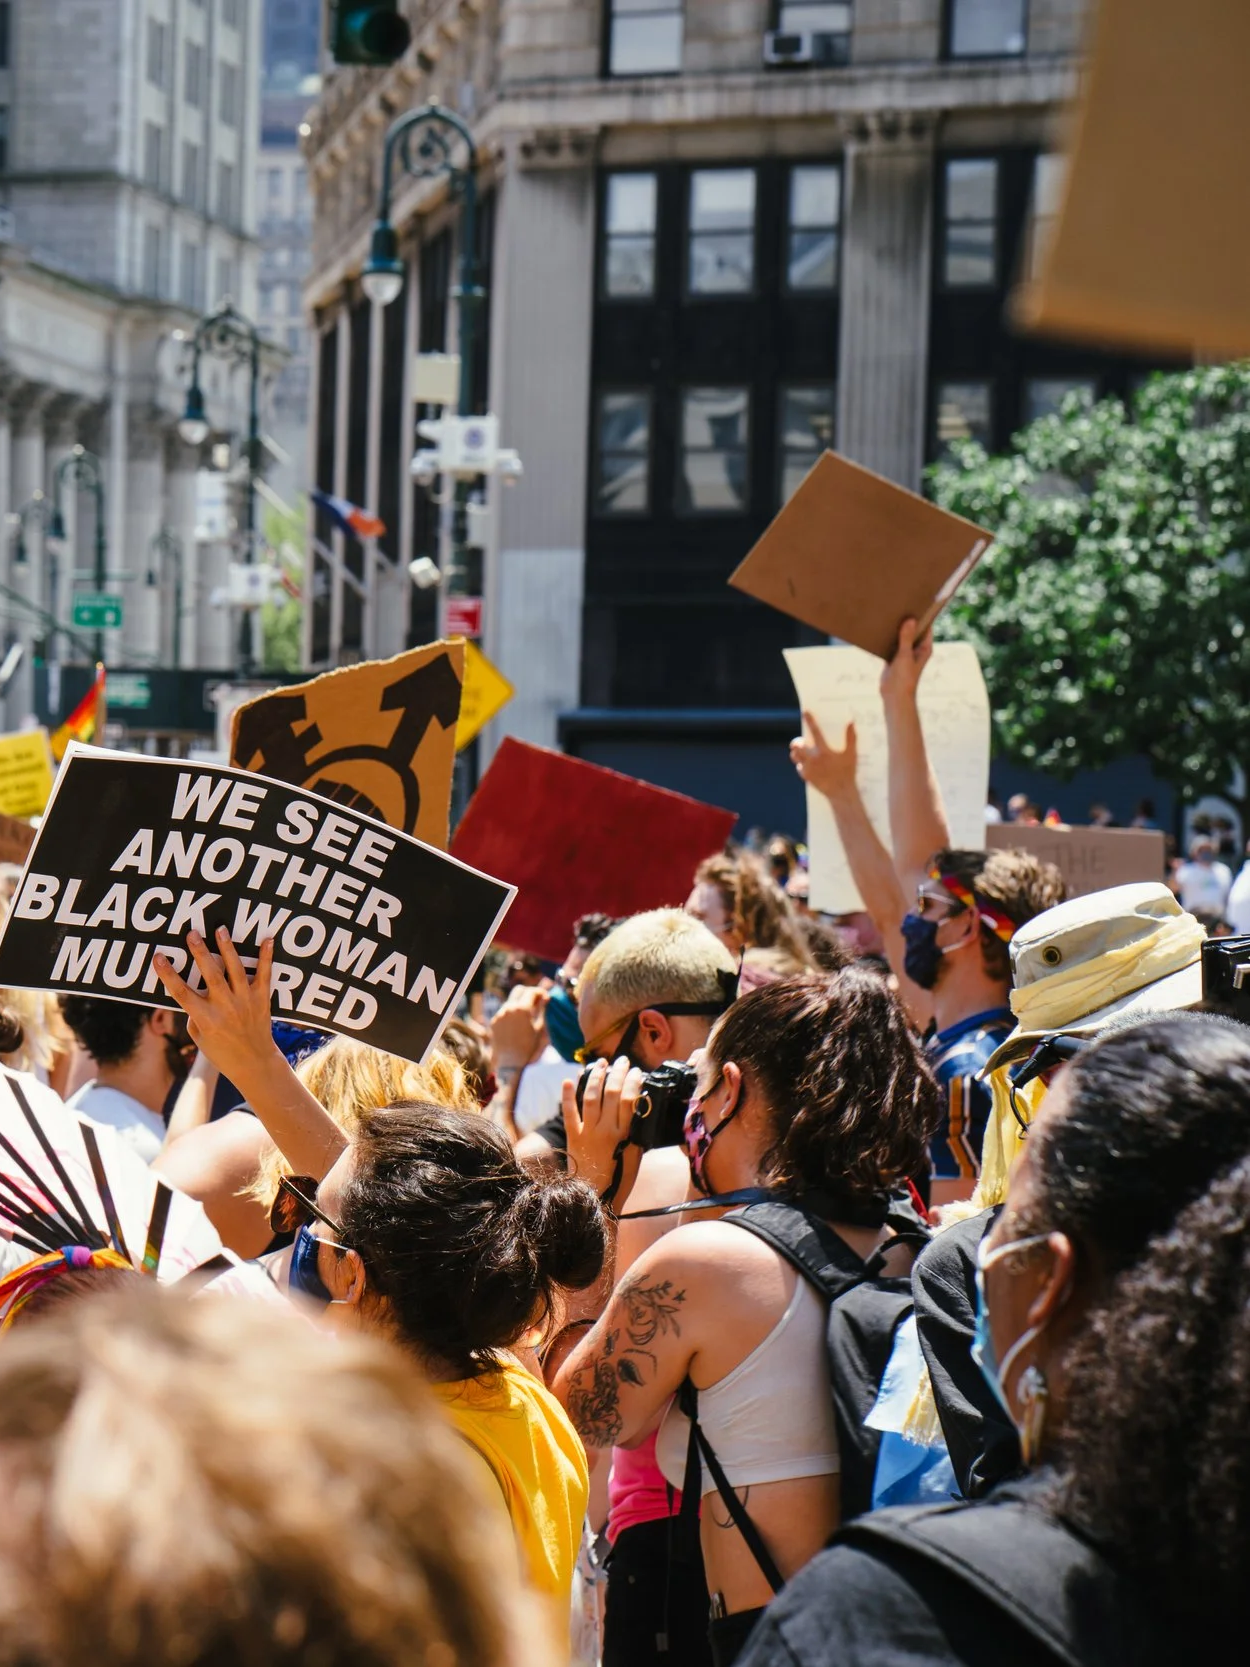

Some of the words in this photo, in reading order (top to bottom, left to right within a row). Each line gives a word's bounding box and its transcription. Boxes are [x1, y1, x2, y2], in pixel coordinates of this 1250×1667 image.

[170, 772, 269, 831] WE
[276, 800, 397, 878] SEE
[110, 828, 403, 938] ANOTHER
[13, 872, 222, 938] BLACK
[232, 897, 458, 1016] WOMAN
[50, 935, 379, 1032] MURRED
